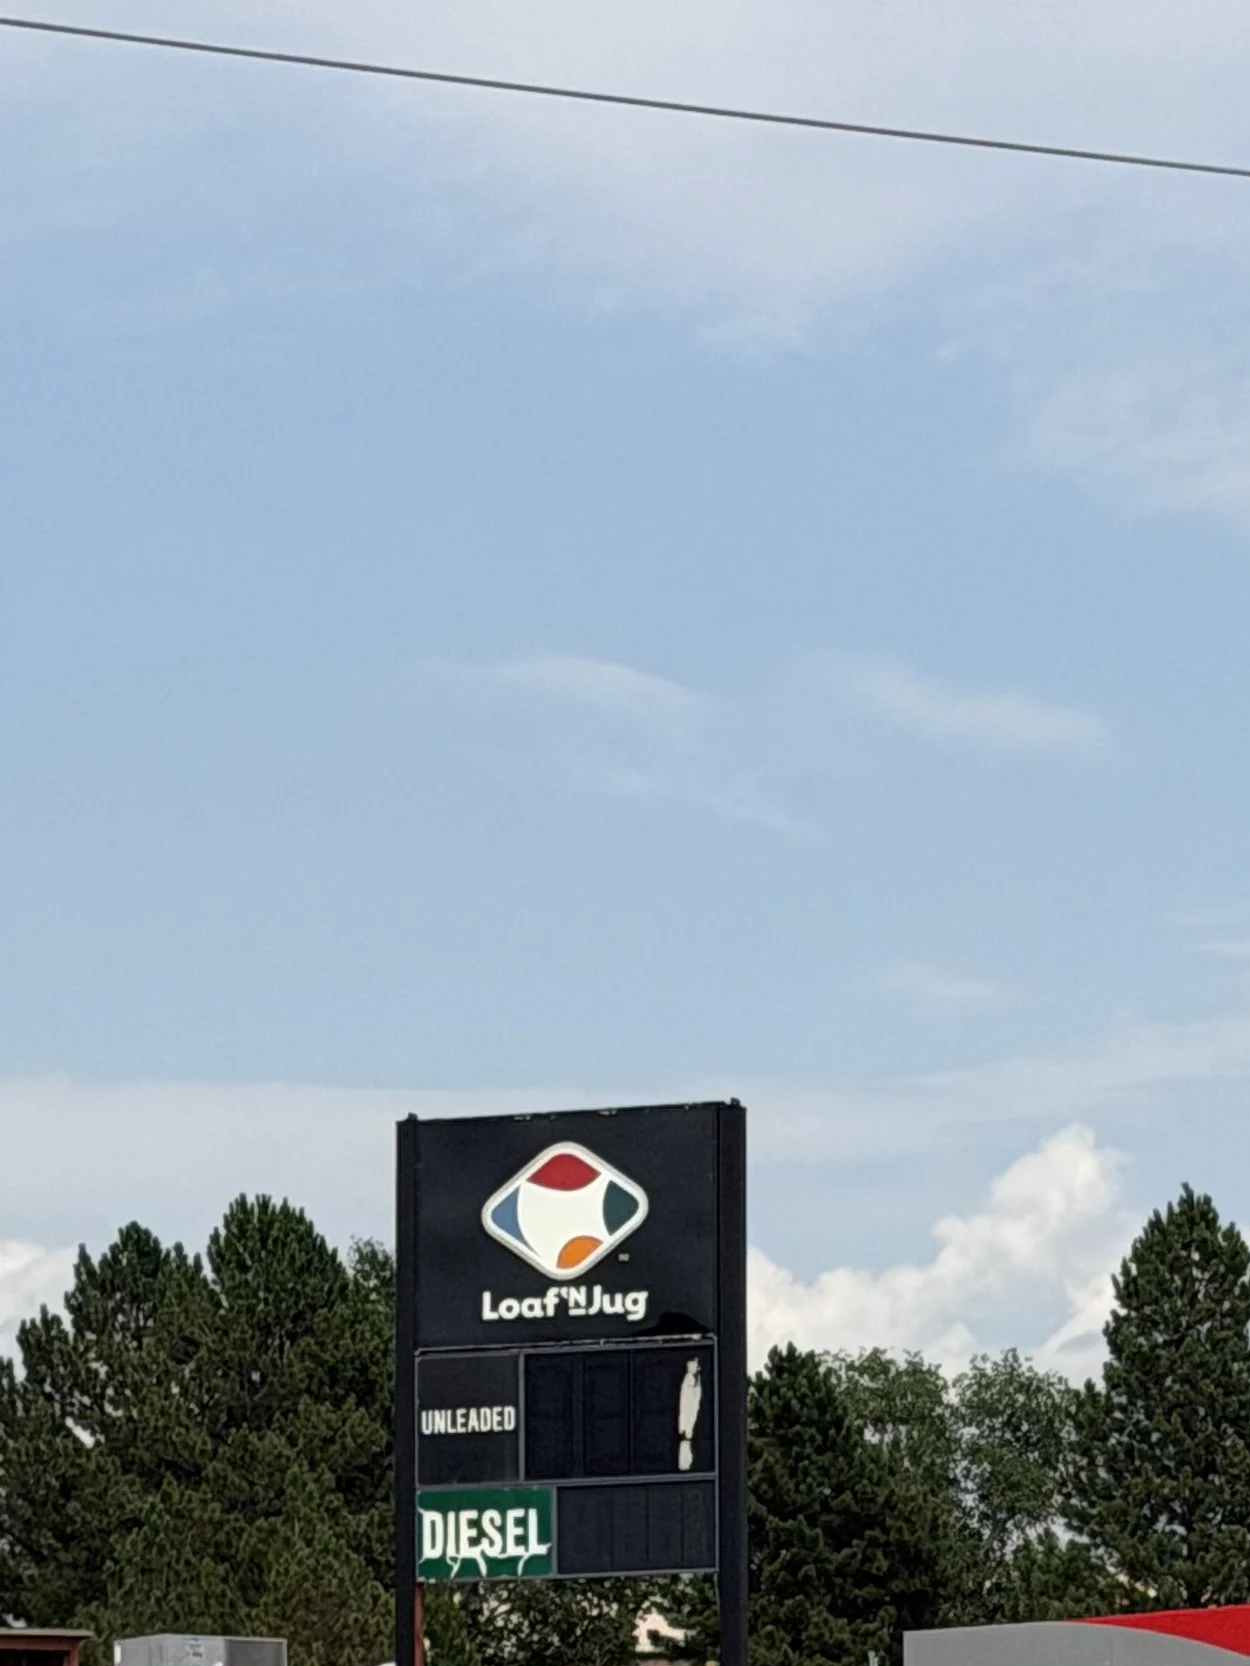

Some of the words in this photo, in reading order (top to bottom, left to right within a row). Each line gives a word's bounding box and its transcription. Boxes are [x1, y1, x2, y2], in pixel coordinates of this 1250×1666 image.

[482, 1286, 560, 1321] Loaf
[588, 1284, 649, 1322] Jug
[421, 1405, 516, 1435] UNLEADED
[422, 1507, 550, 1559] DIESEL
